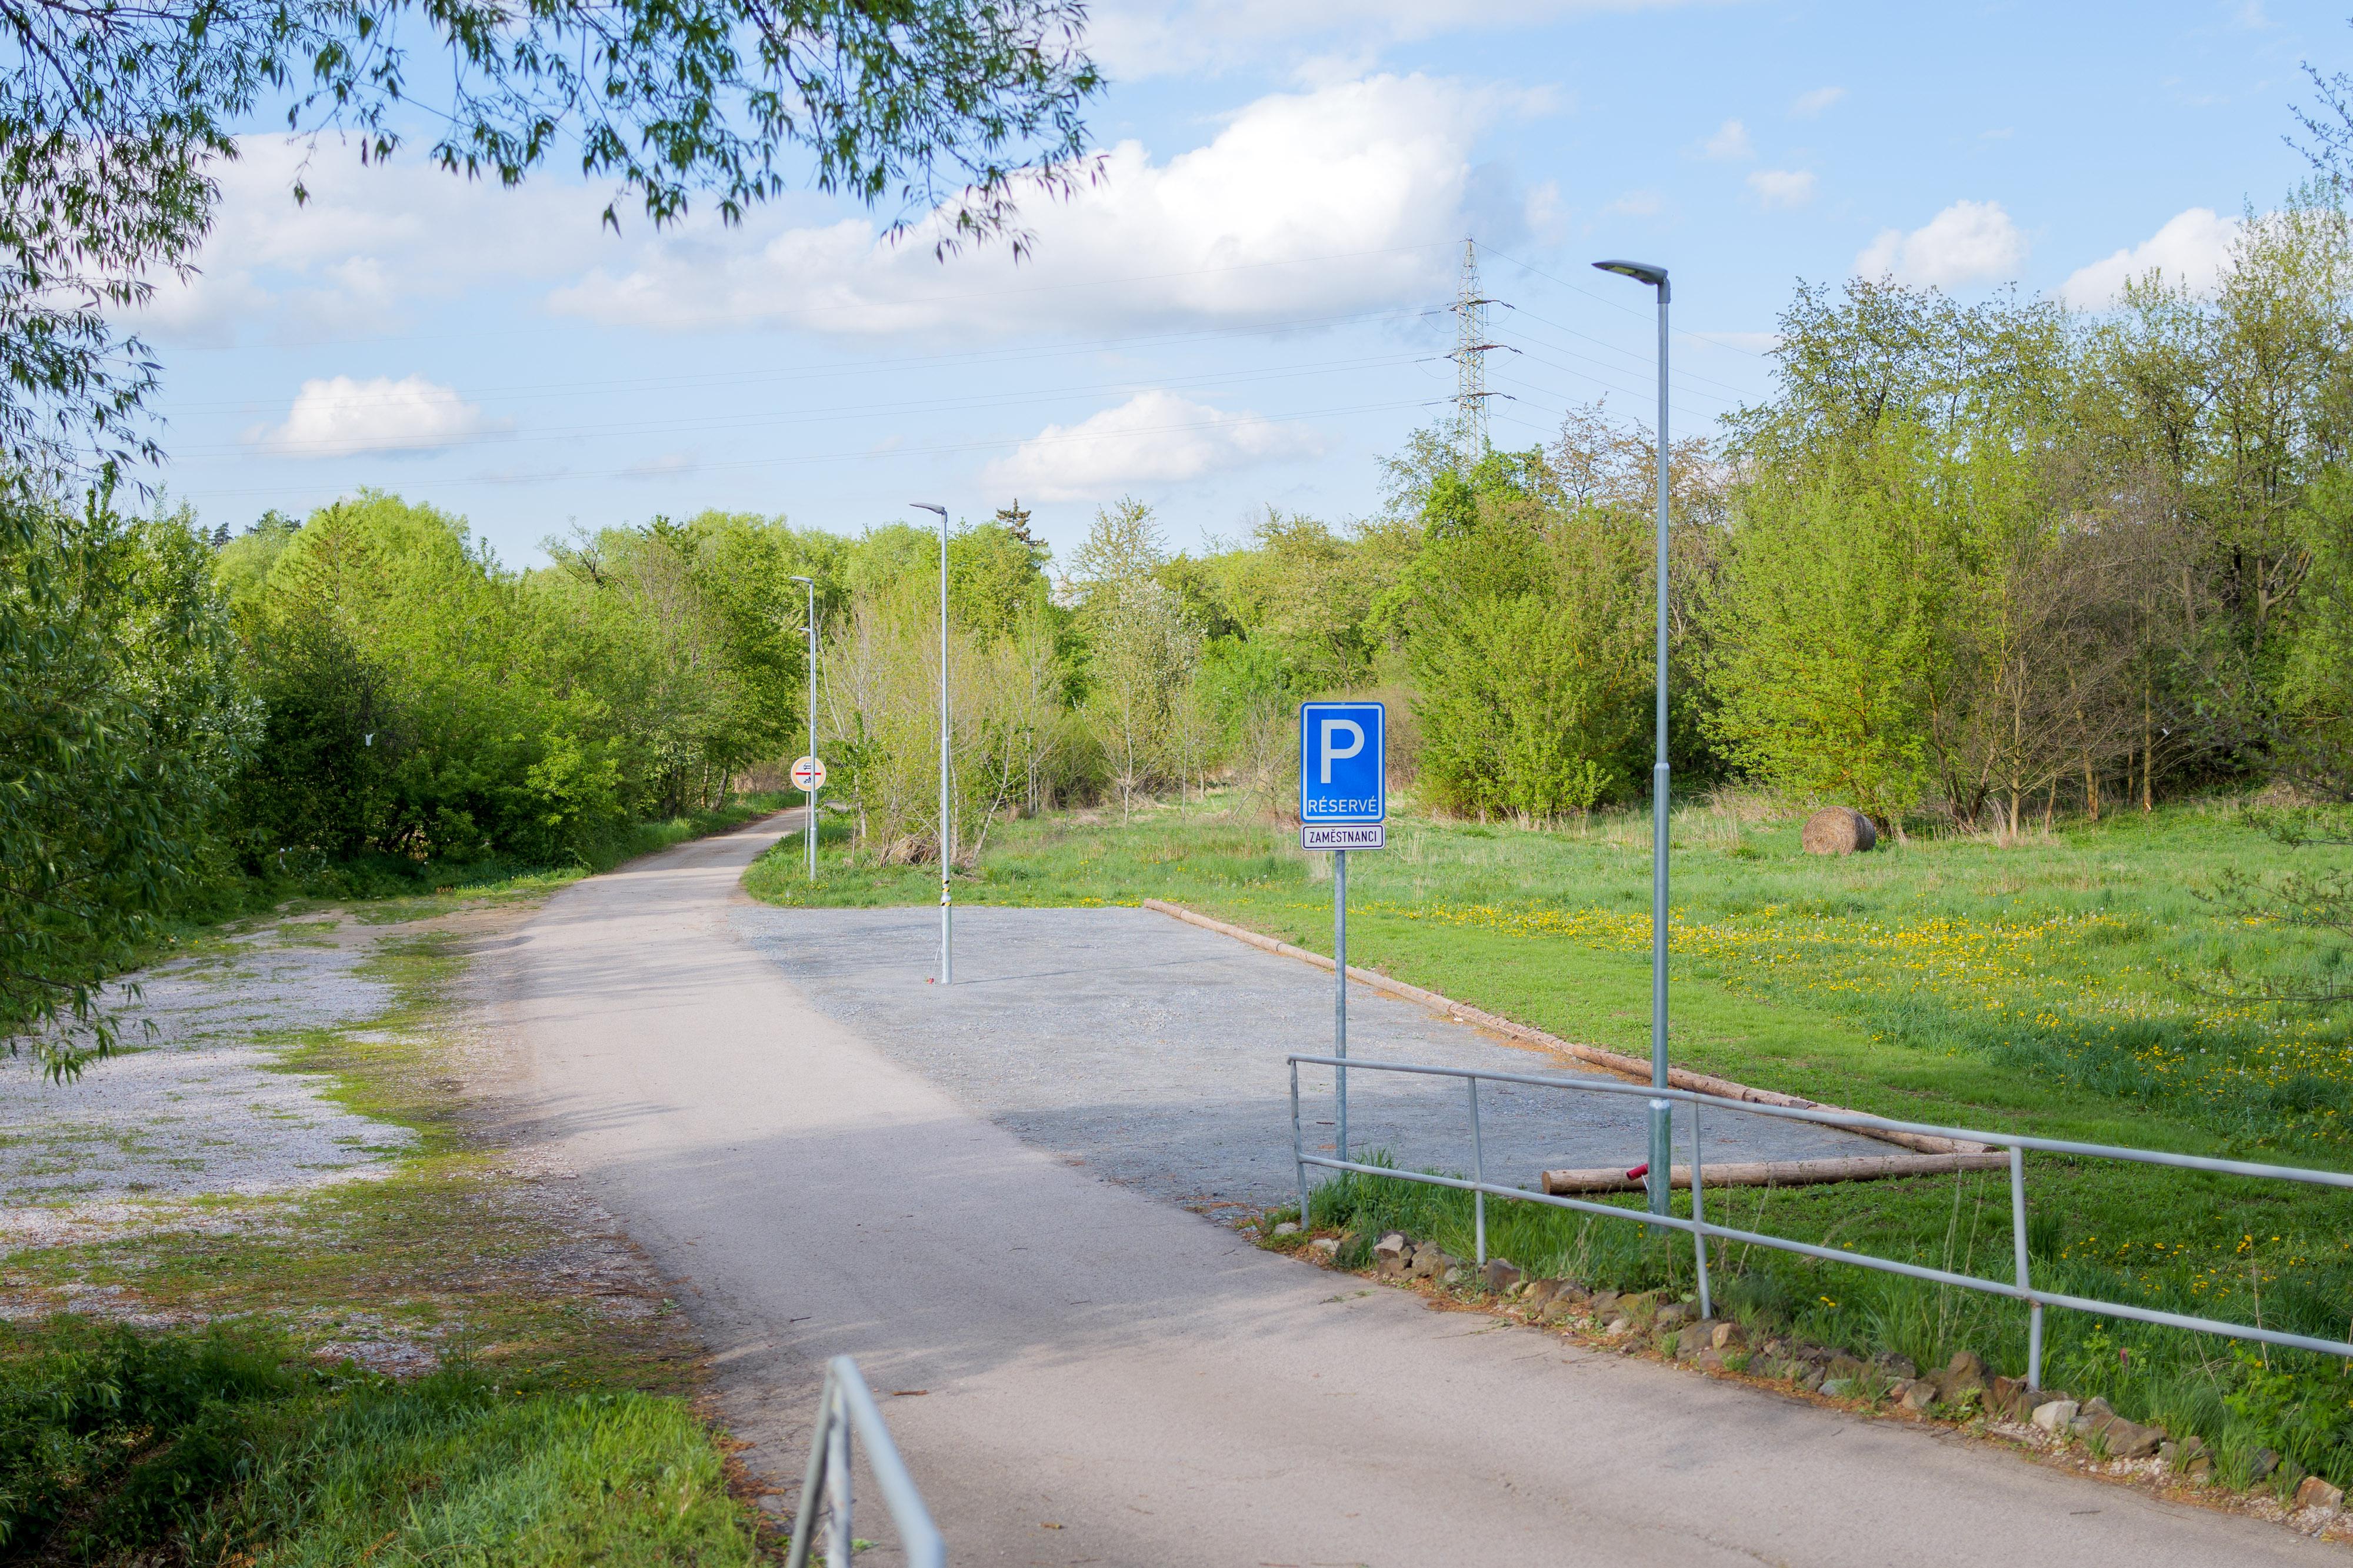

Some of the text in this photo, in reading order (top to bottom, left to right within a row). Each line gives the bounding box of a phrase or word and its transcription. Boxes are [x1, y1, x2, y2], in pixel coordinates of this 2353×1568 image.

[1321, 719, 1365, 783] P
[1308, 795, 1377, 813] RÉSERVÉ
[1309, 829, 1377, 843] ZAMĚSTNANCI
